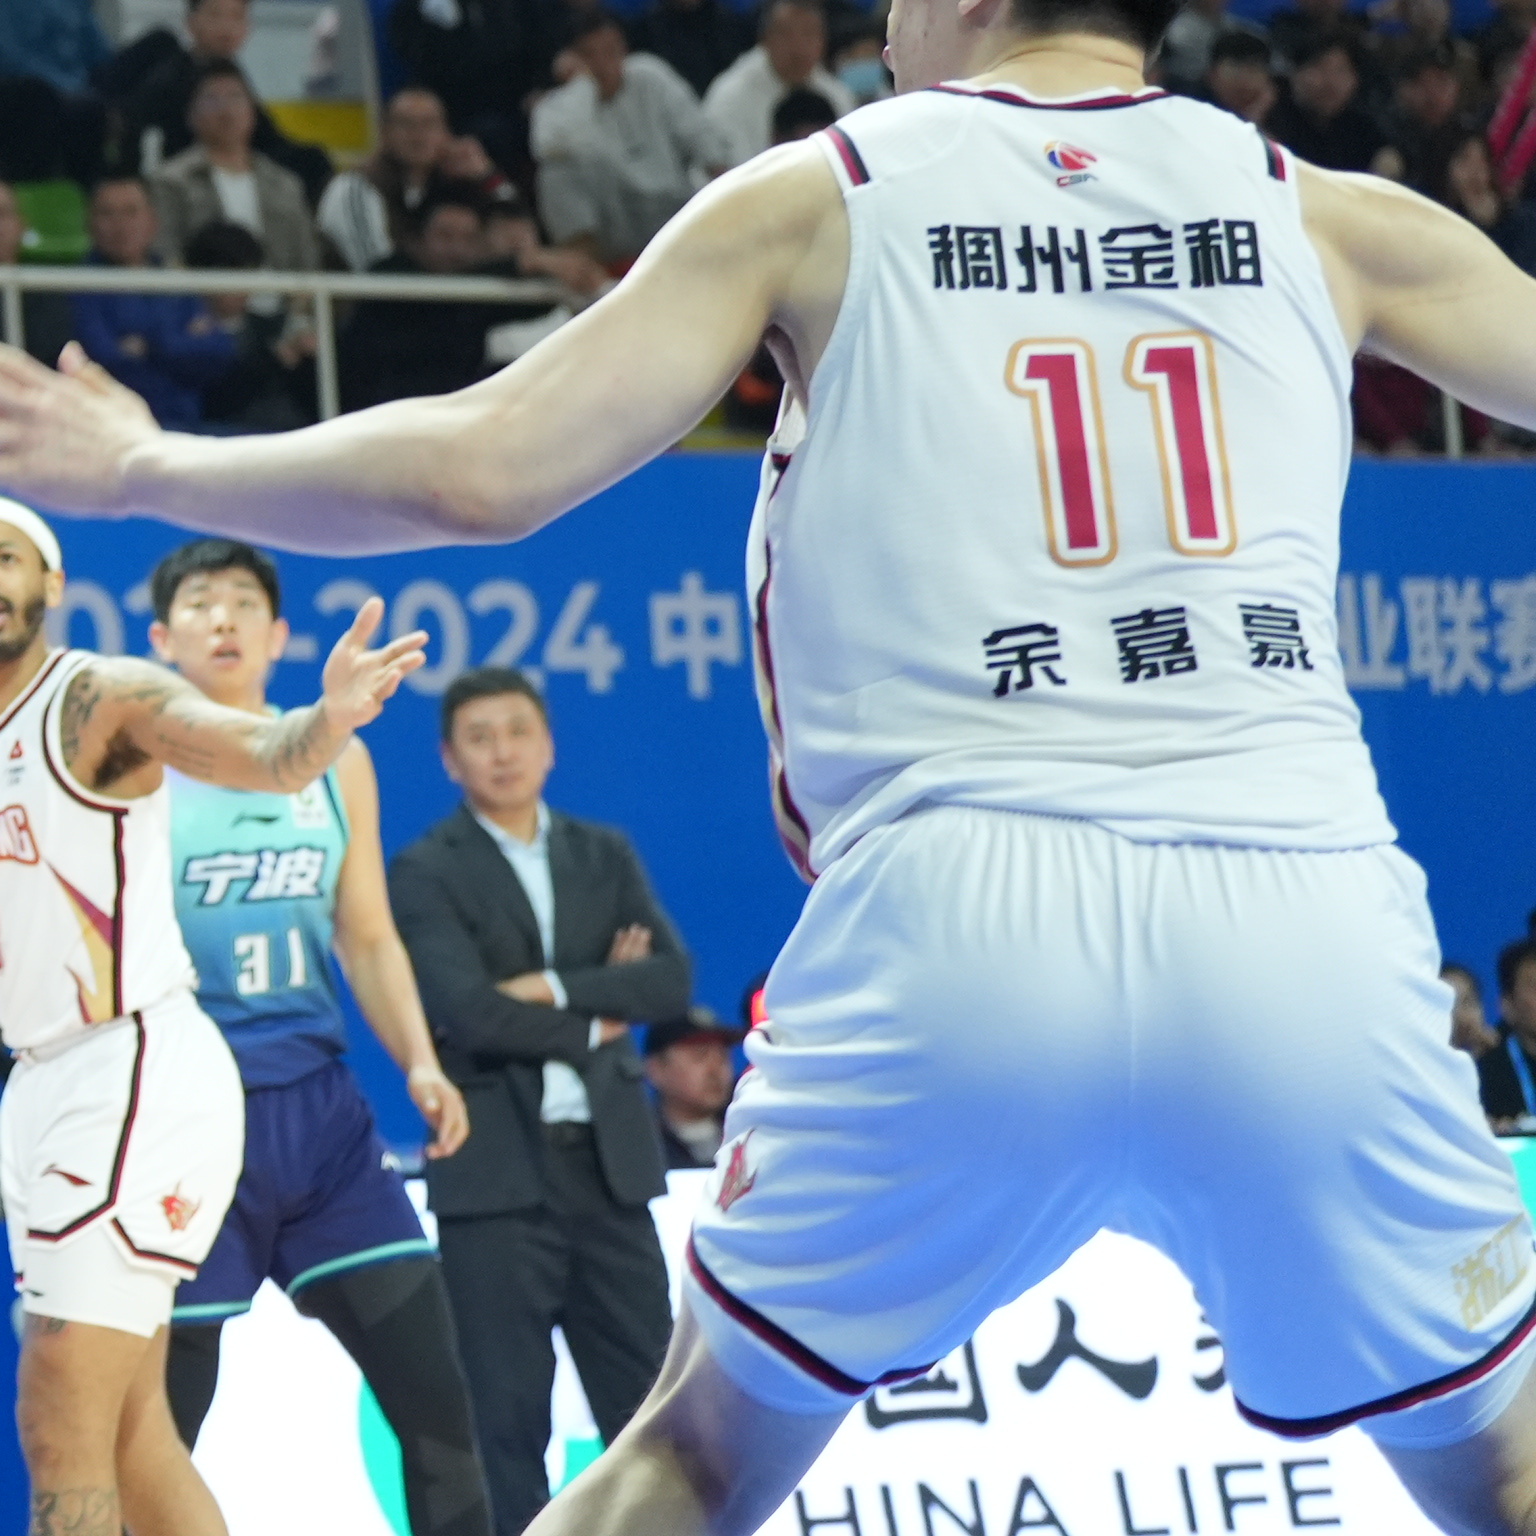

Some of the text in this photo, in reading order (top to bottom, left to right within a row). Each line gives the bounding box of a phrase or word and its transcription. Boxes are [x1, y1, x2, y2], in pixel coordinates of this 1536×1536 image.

[928, 218, 1264, 294] 稠州金租
[1006, 332, 1236, 566] 11
[981, 603, 1314, 698] 余嘉豪
[181, 846, 325, 906] 宁波
[233, 927, 307, 997] 31
[794, 1457, 1341, 1536] HINA LIFE
